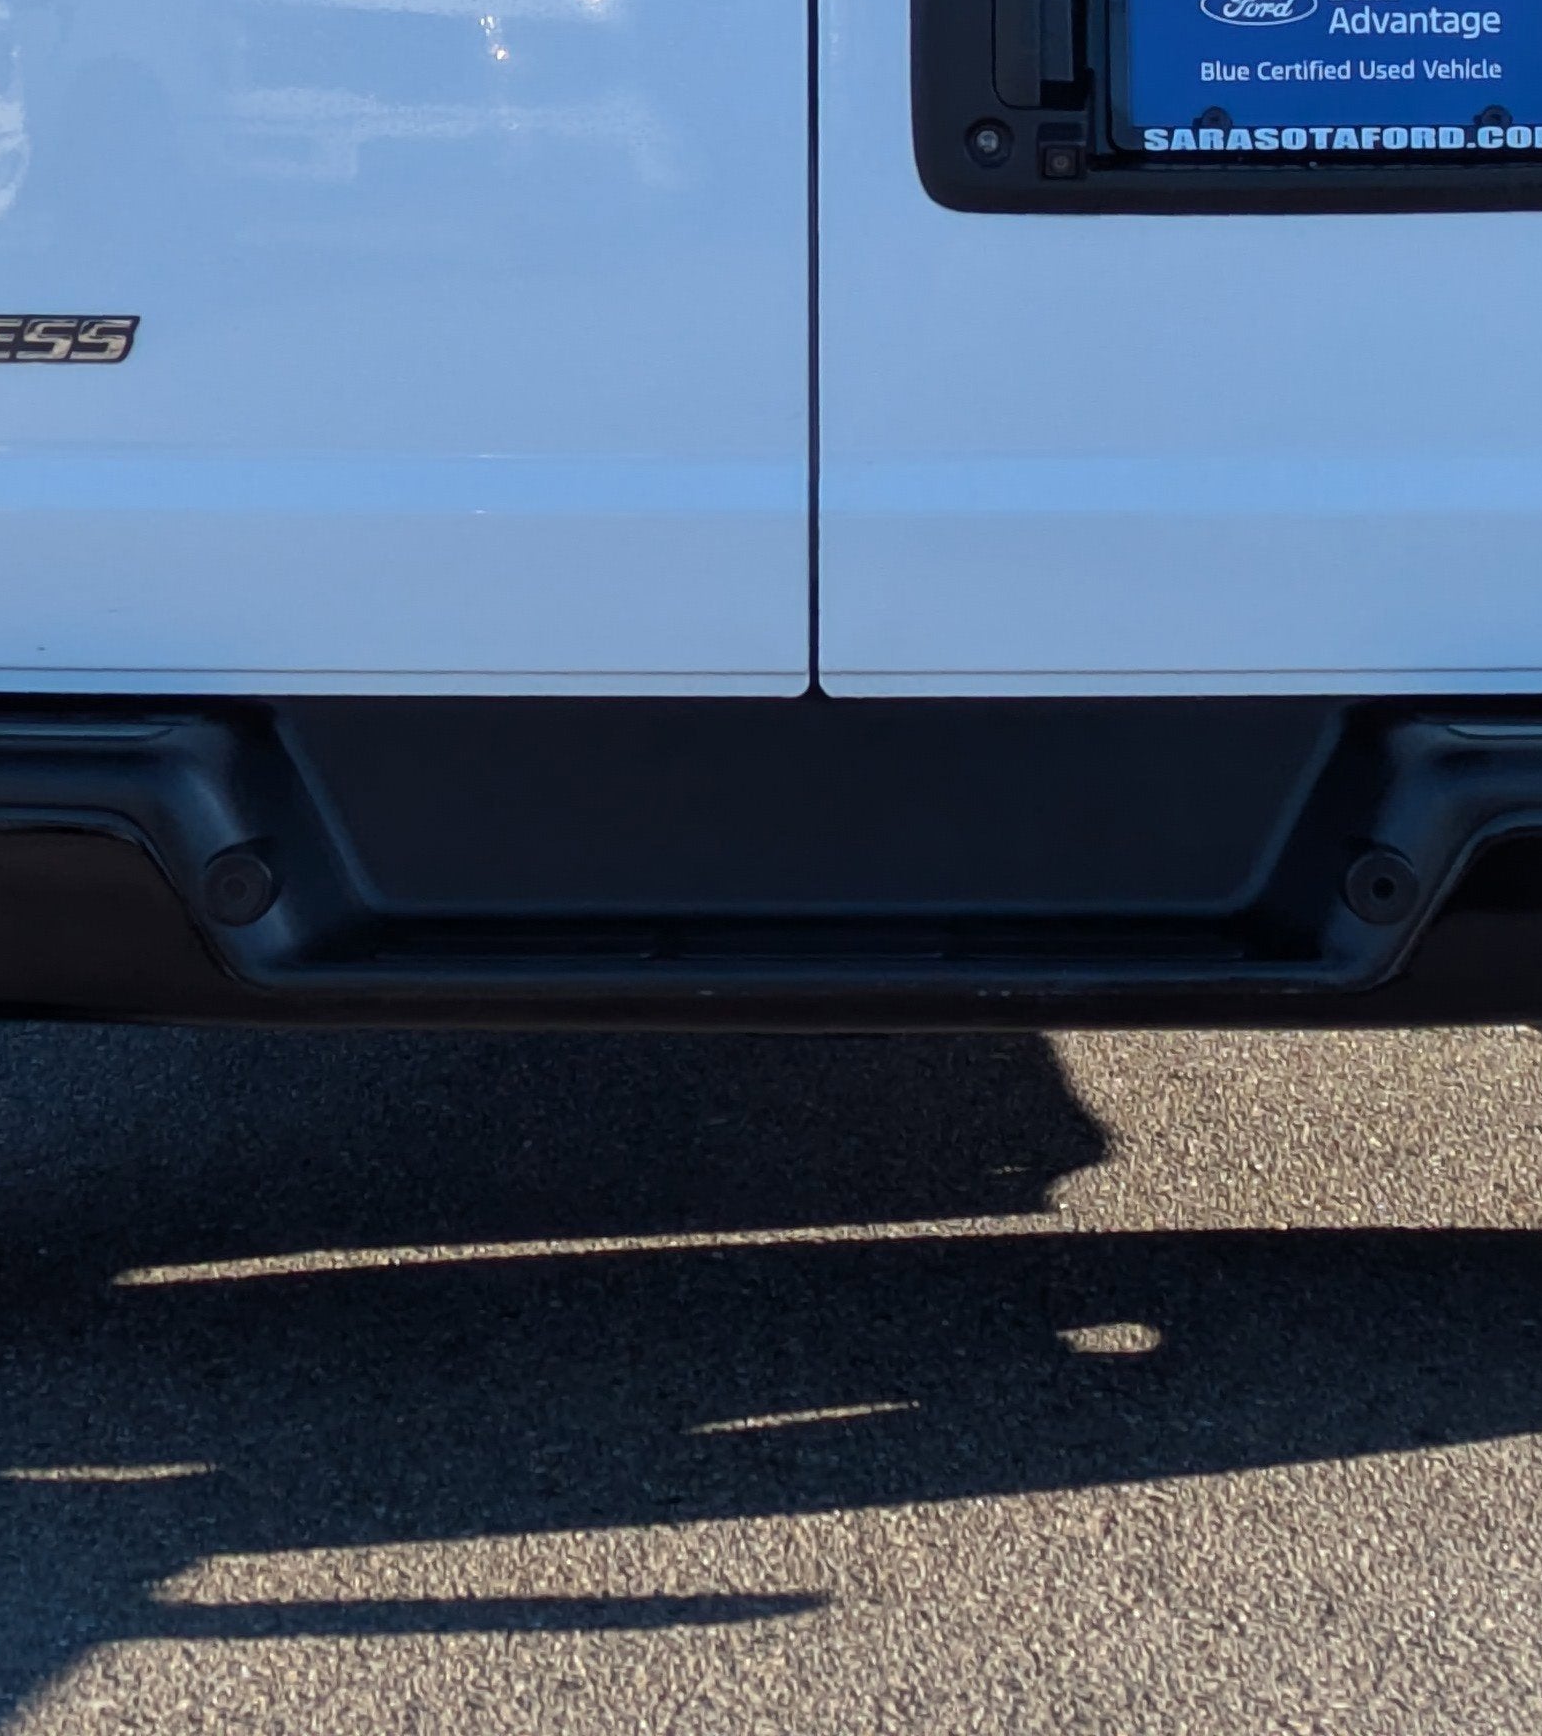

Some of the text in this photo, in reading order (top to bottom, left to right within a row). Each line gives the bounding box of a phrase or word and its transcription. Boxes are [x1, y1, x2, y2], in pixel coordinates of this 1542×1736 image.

[1328, 6, 1502, 39] Advantage
[1201, 58, 1502, 81] Blue Certified Used Vehicle
